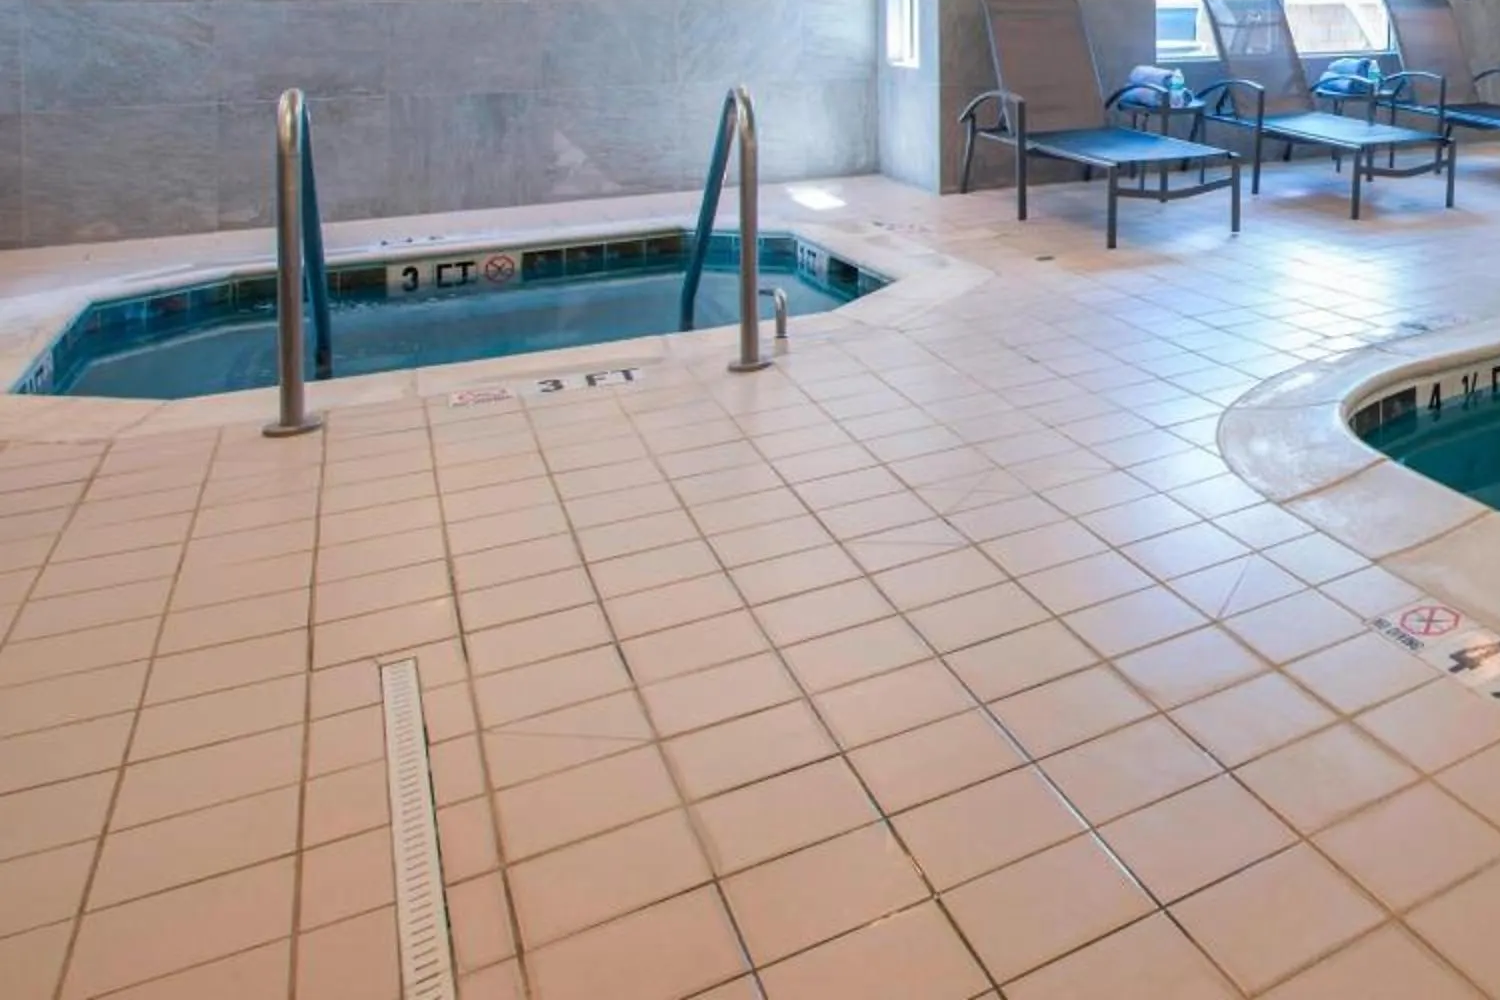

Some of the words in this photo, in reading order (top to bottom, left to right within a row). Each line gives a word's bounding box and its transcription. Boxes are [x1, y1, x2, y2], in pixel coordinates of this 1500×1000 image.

[402, 265, 419, 292] 3
[537, 378, 565, 393] 3
[585, 367, 640, 387] FT
